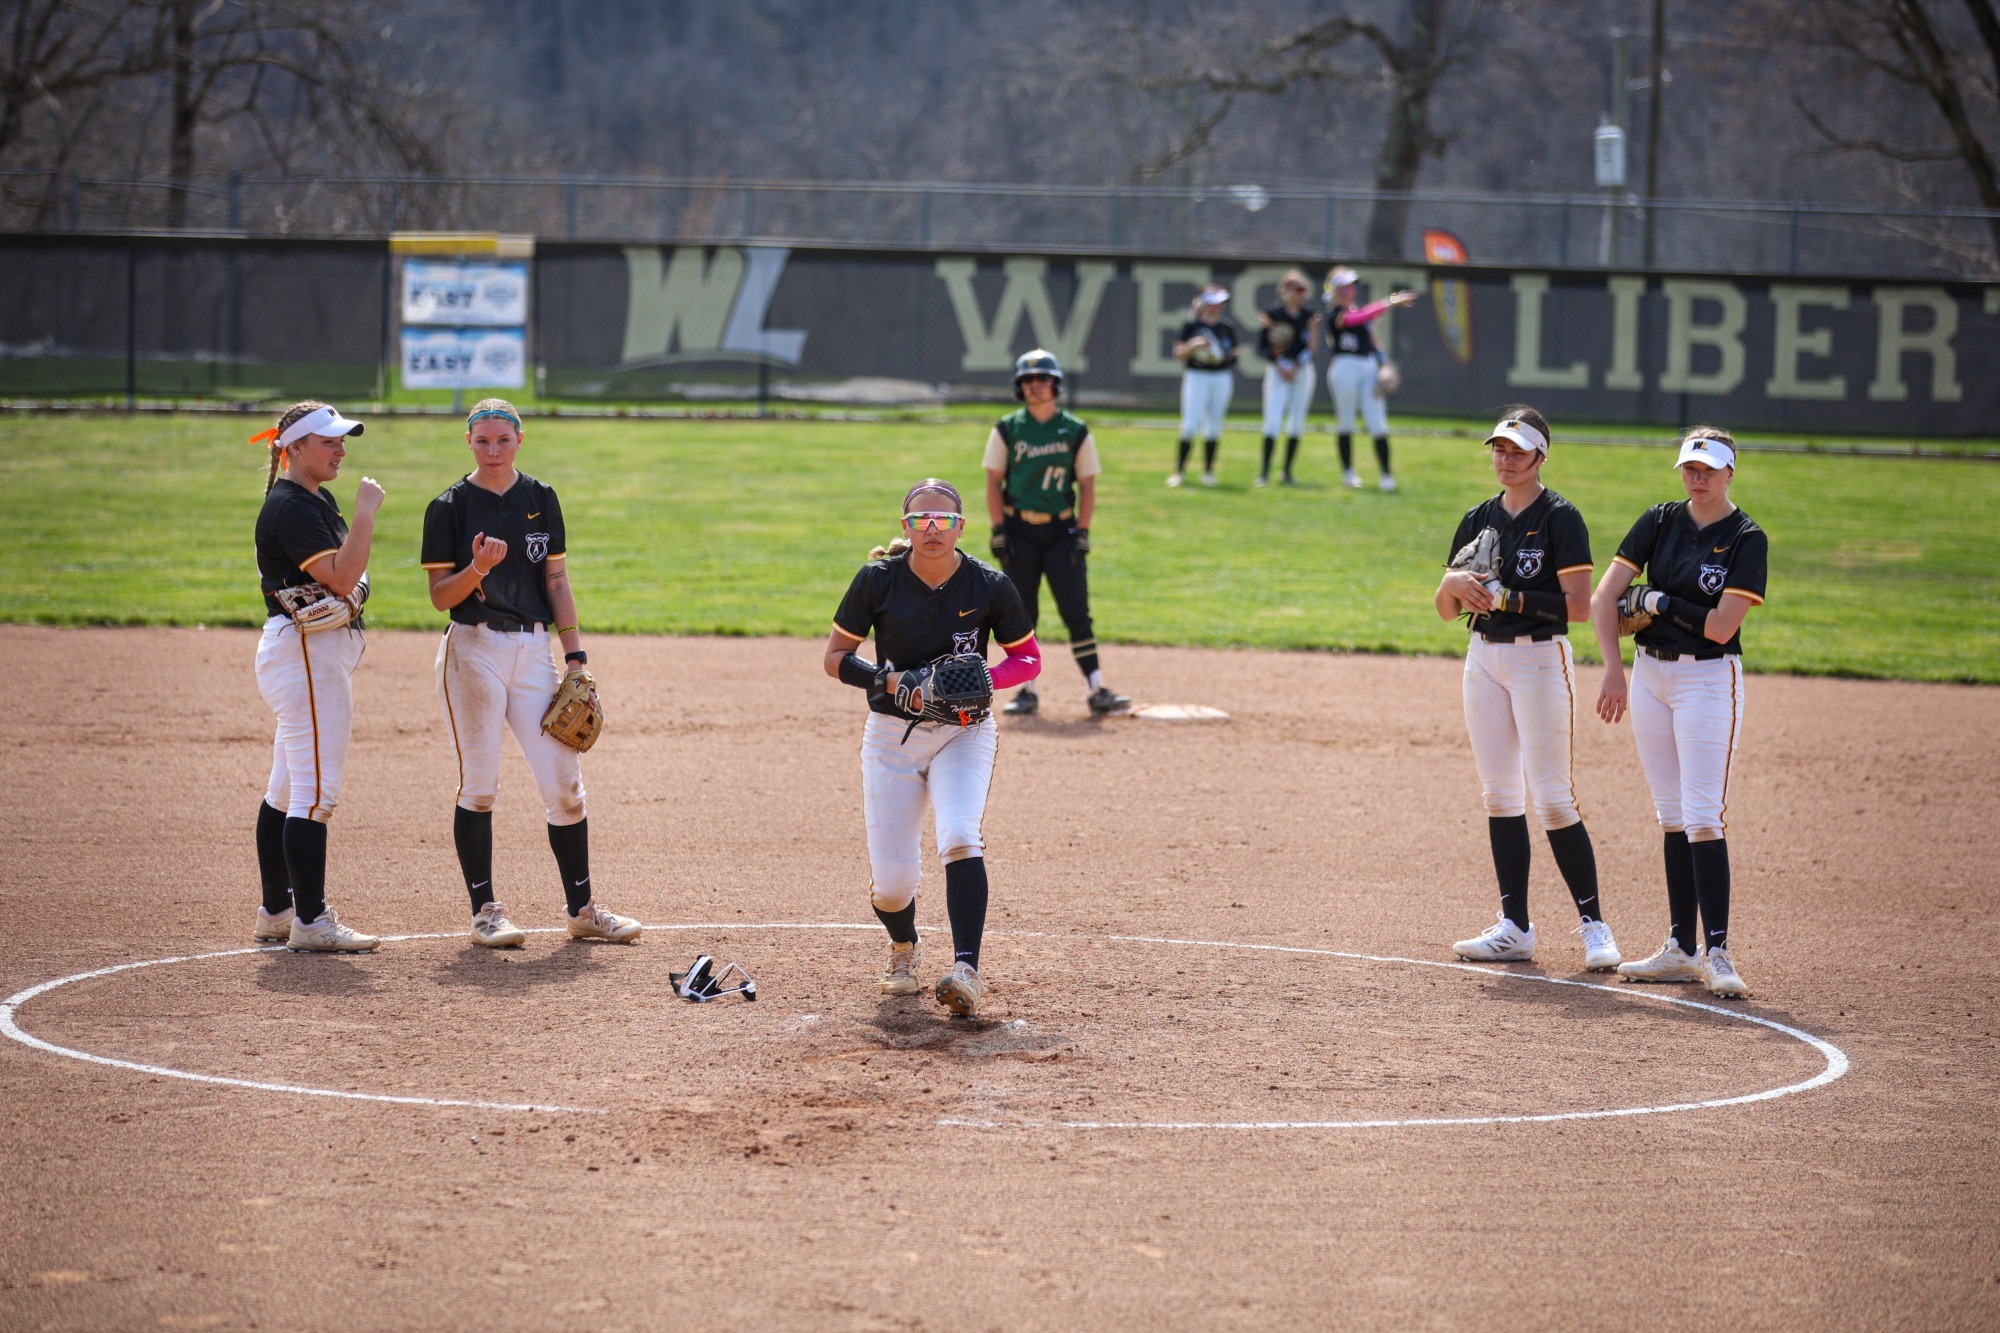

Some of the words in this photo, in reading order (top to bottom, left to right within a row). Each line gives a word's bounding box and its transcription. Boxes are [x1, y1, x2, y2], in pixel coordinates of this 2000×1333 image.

[622, 246, 808, 366] WL
[935, 256, 1426, 379] WEST
[1507, 273, 2000, 400] LIBER
[1692, 441, 1708, 450] WL
[1041, 465, 1067, 492] 17
[307, 604, 330, 618] A2000
